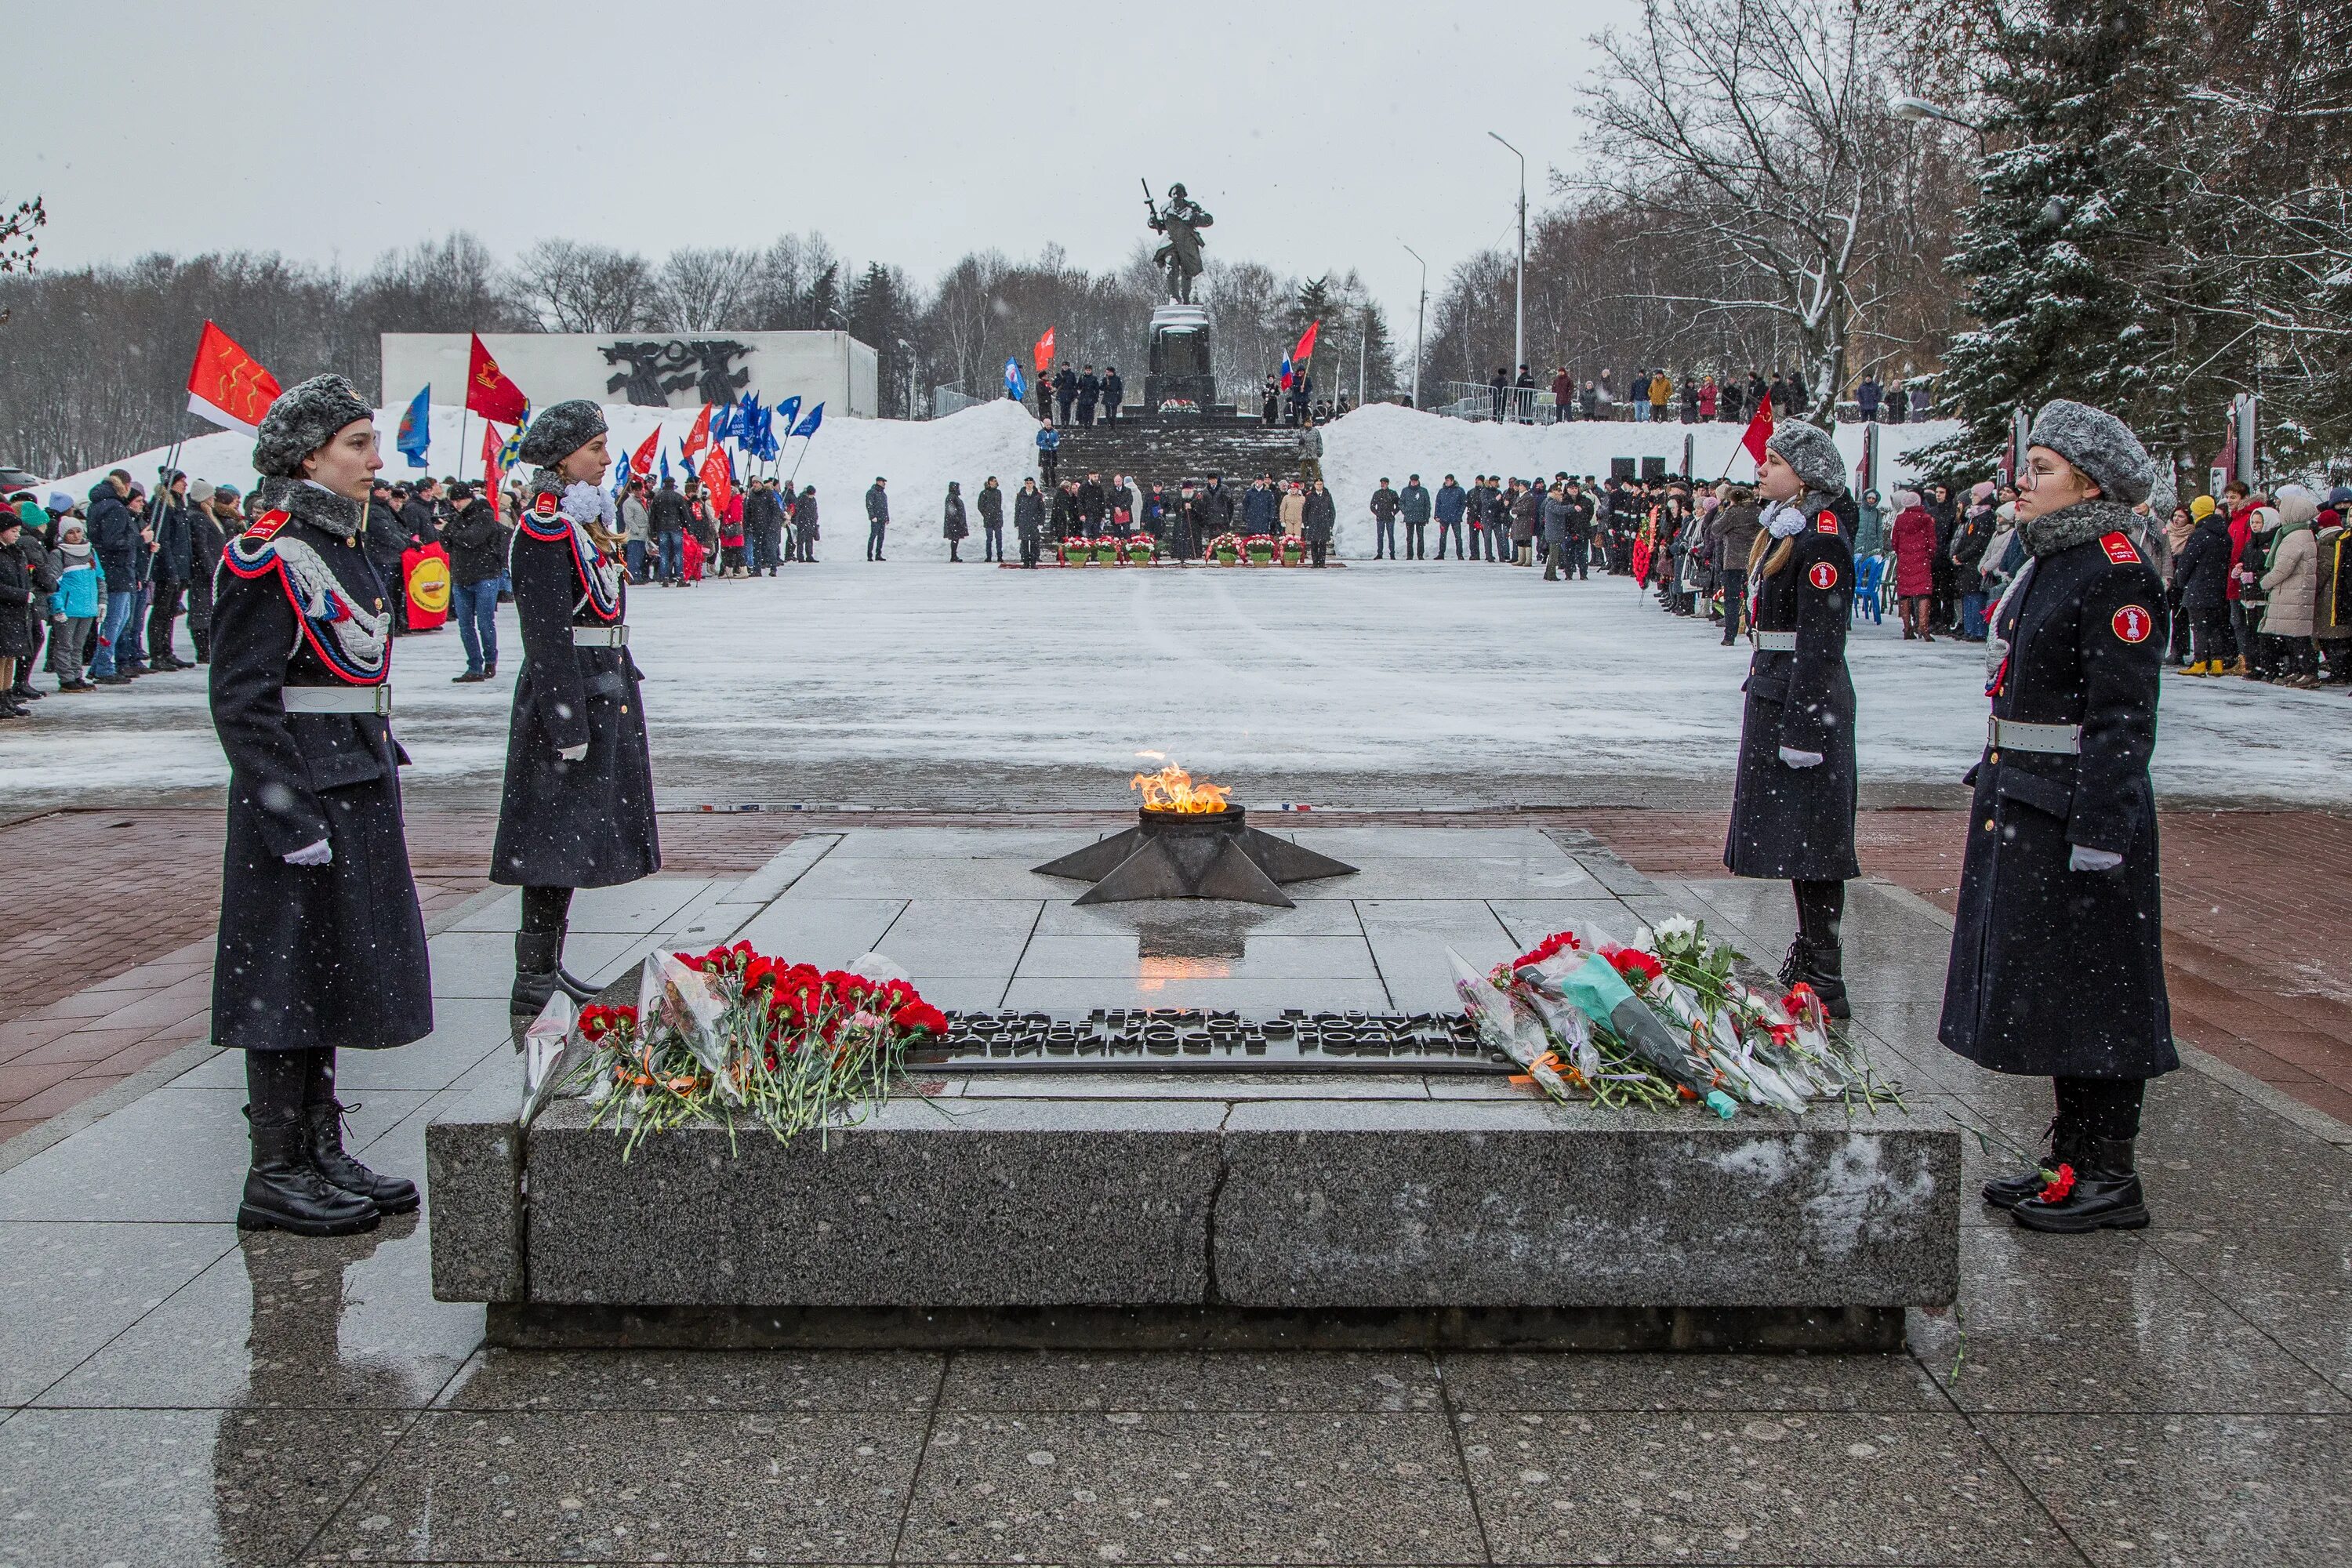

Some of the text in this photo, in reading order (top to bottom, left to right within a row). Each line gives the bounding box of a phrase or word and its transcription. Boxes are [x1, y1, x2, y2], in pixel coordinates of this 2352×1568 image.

[943, 1008, 1051, 1021] ЛАВА
[947, 1020, 1093, 1034] БОРЬБЕ
[1124, 1019, 1175, 1033] ЗА
[1207, 1019, 1412, 1034] СВОБОДУ
[938, 1032, 1267, 1048] ЗАВИСИМОСТЬ
